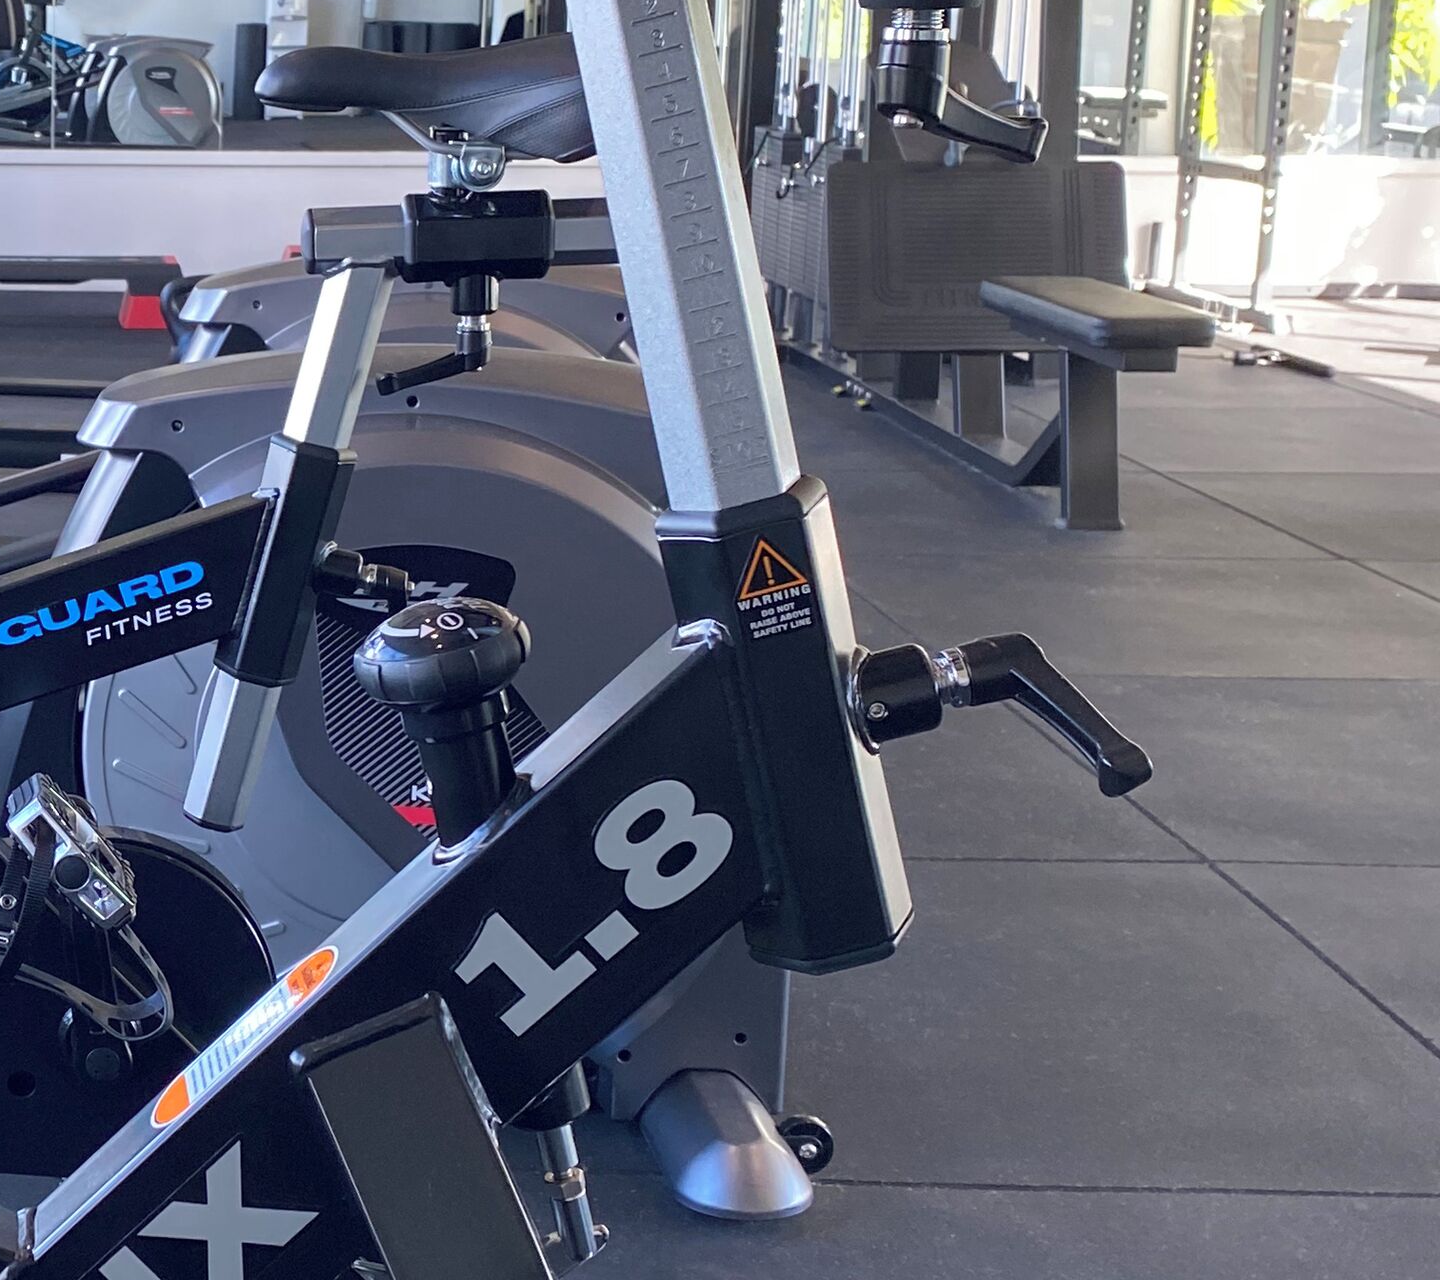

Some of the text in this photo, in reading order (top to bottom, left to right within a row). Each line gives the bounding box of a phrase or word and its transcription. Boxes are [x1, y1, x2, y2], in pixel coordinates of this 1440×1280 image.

[675, 157, 689, 177] 7
[737, 584, 811, 611] WARNING
[86, 593, 213, 646] FITNESS
[750, 607, 811, 630] RAISE ABOVE
[761, 601, 795, 618] DO NOT
[753, 617, 812, 639] SAFETY LINE
[455, 780, 733, 1036] 1.8
